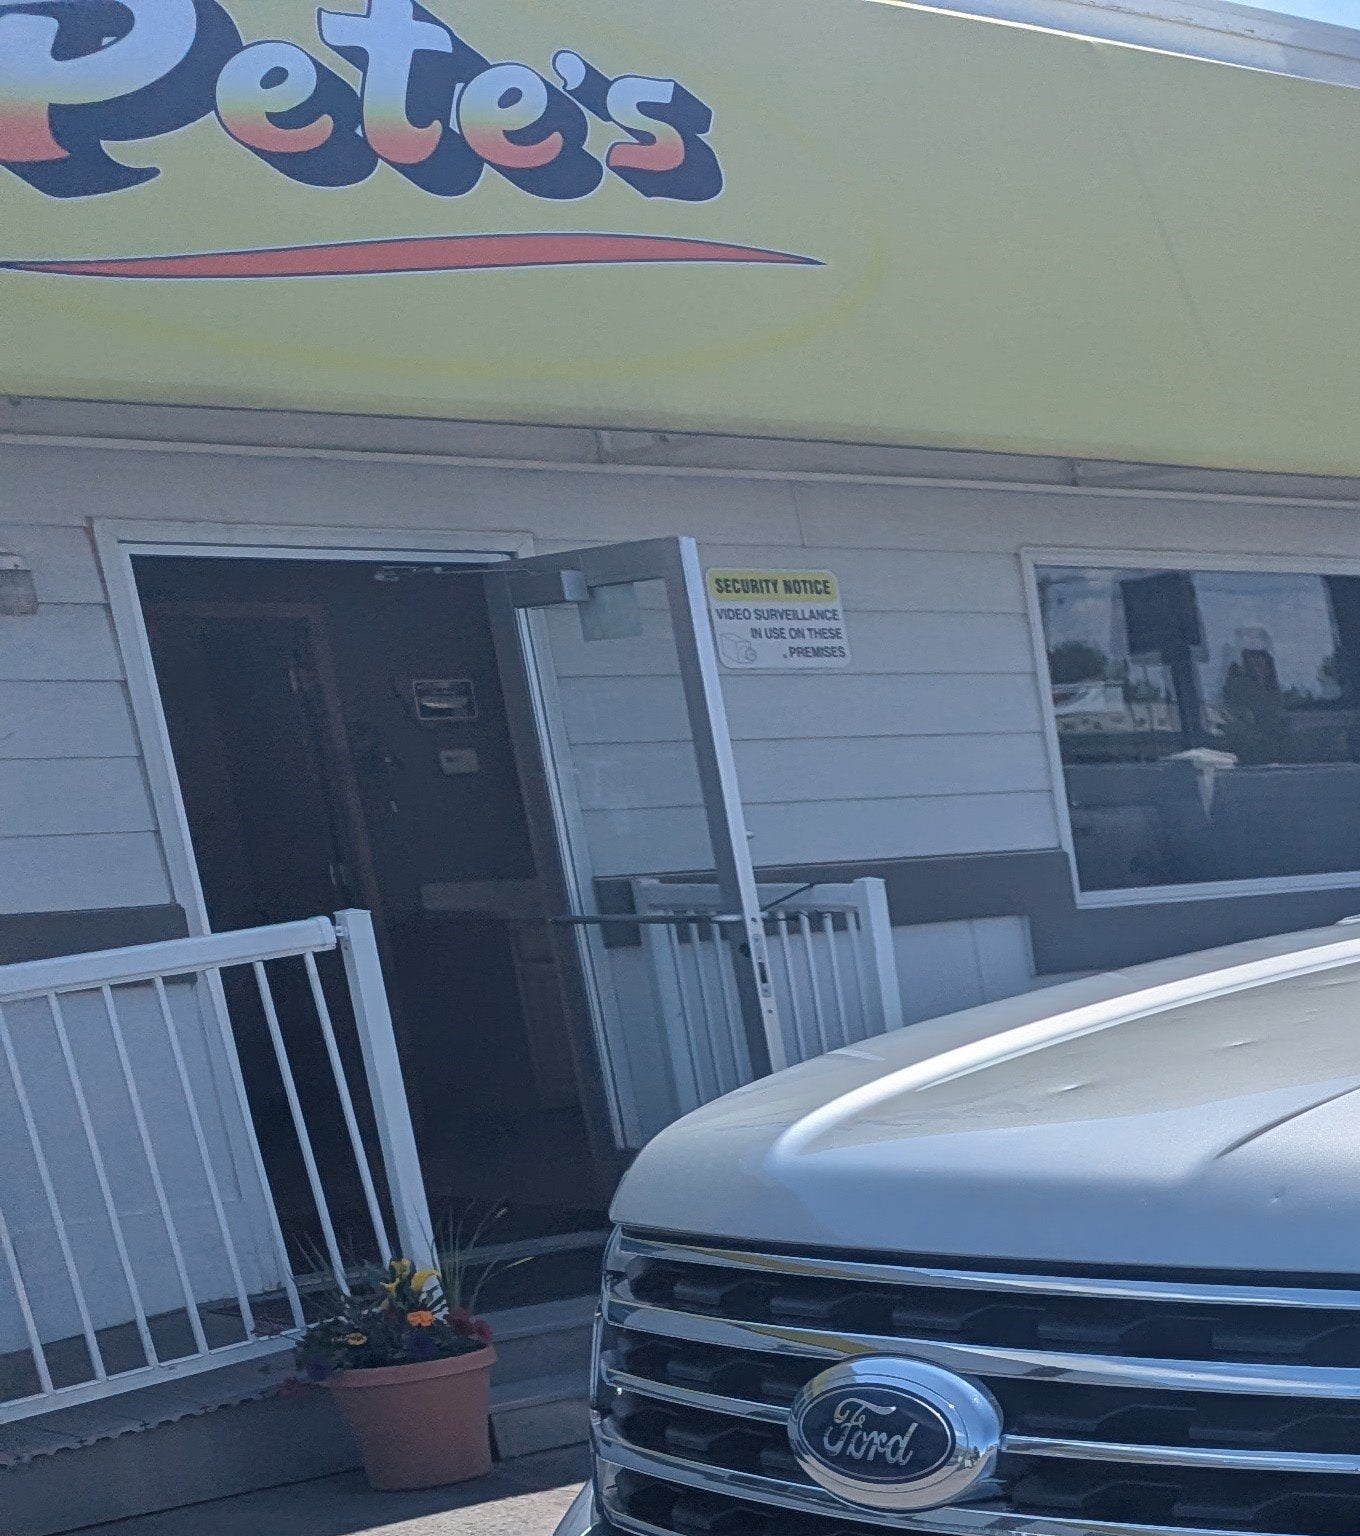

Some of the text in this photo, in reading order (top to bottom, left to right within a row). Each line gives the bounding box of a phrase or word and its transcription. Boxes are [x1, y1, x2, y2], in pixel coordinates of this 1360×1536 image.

[0, 0, 720, 200] Pete's
[715, 578, 832, 595] SECURITY NOTICE
[715, 607, 840, 621] VIDEO SURVEILLANCE
[750, 627, 843, 640] IN USE ON THESE
[823, 1398, 919, 1467] Ford
